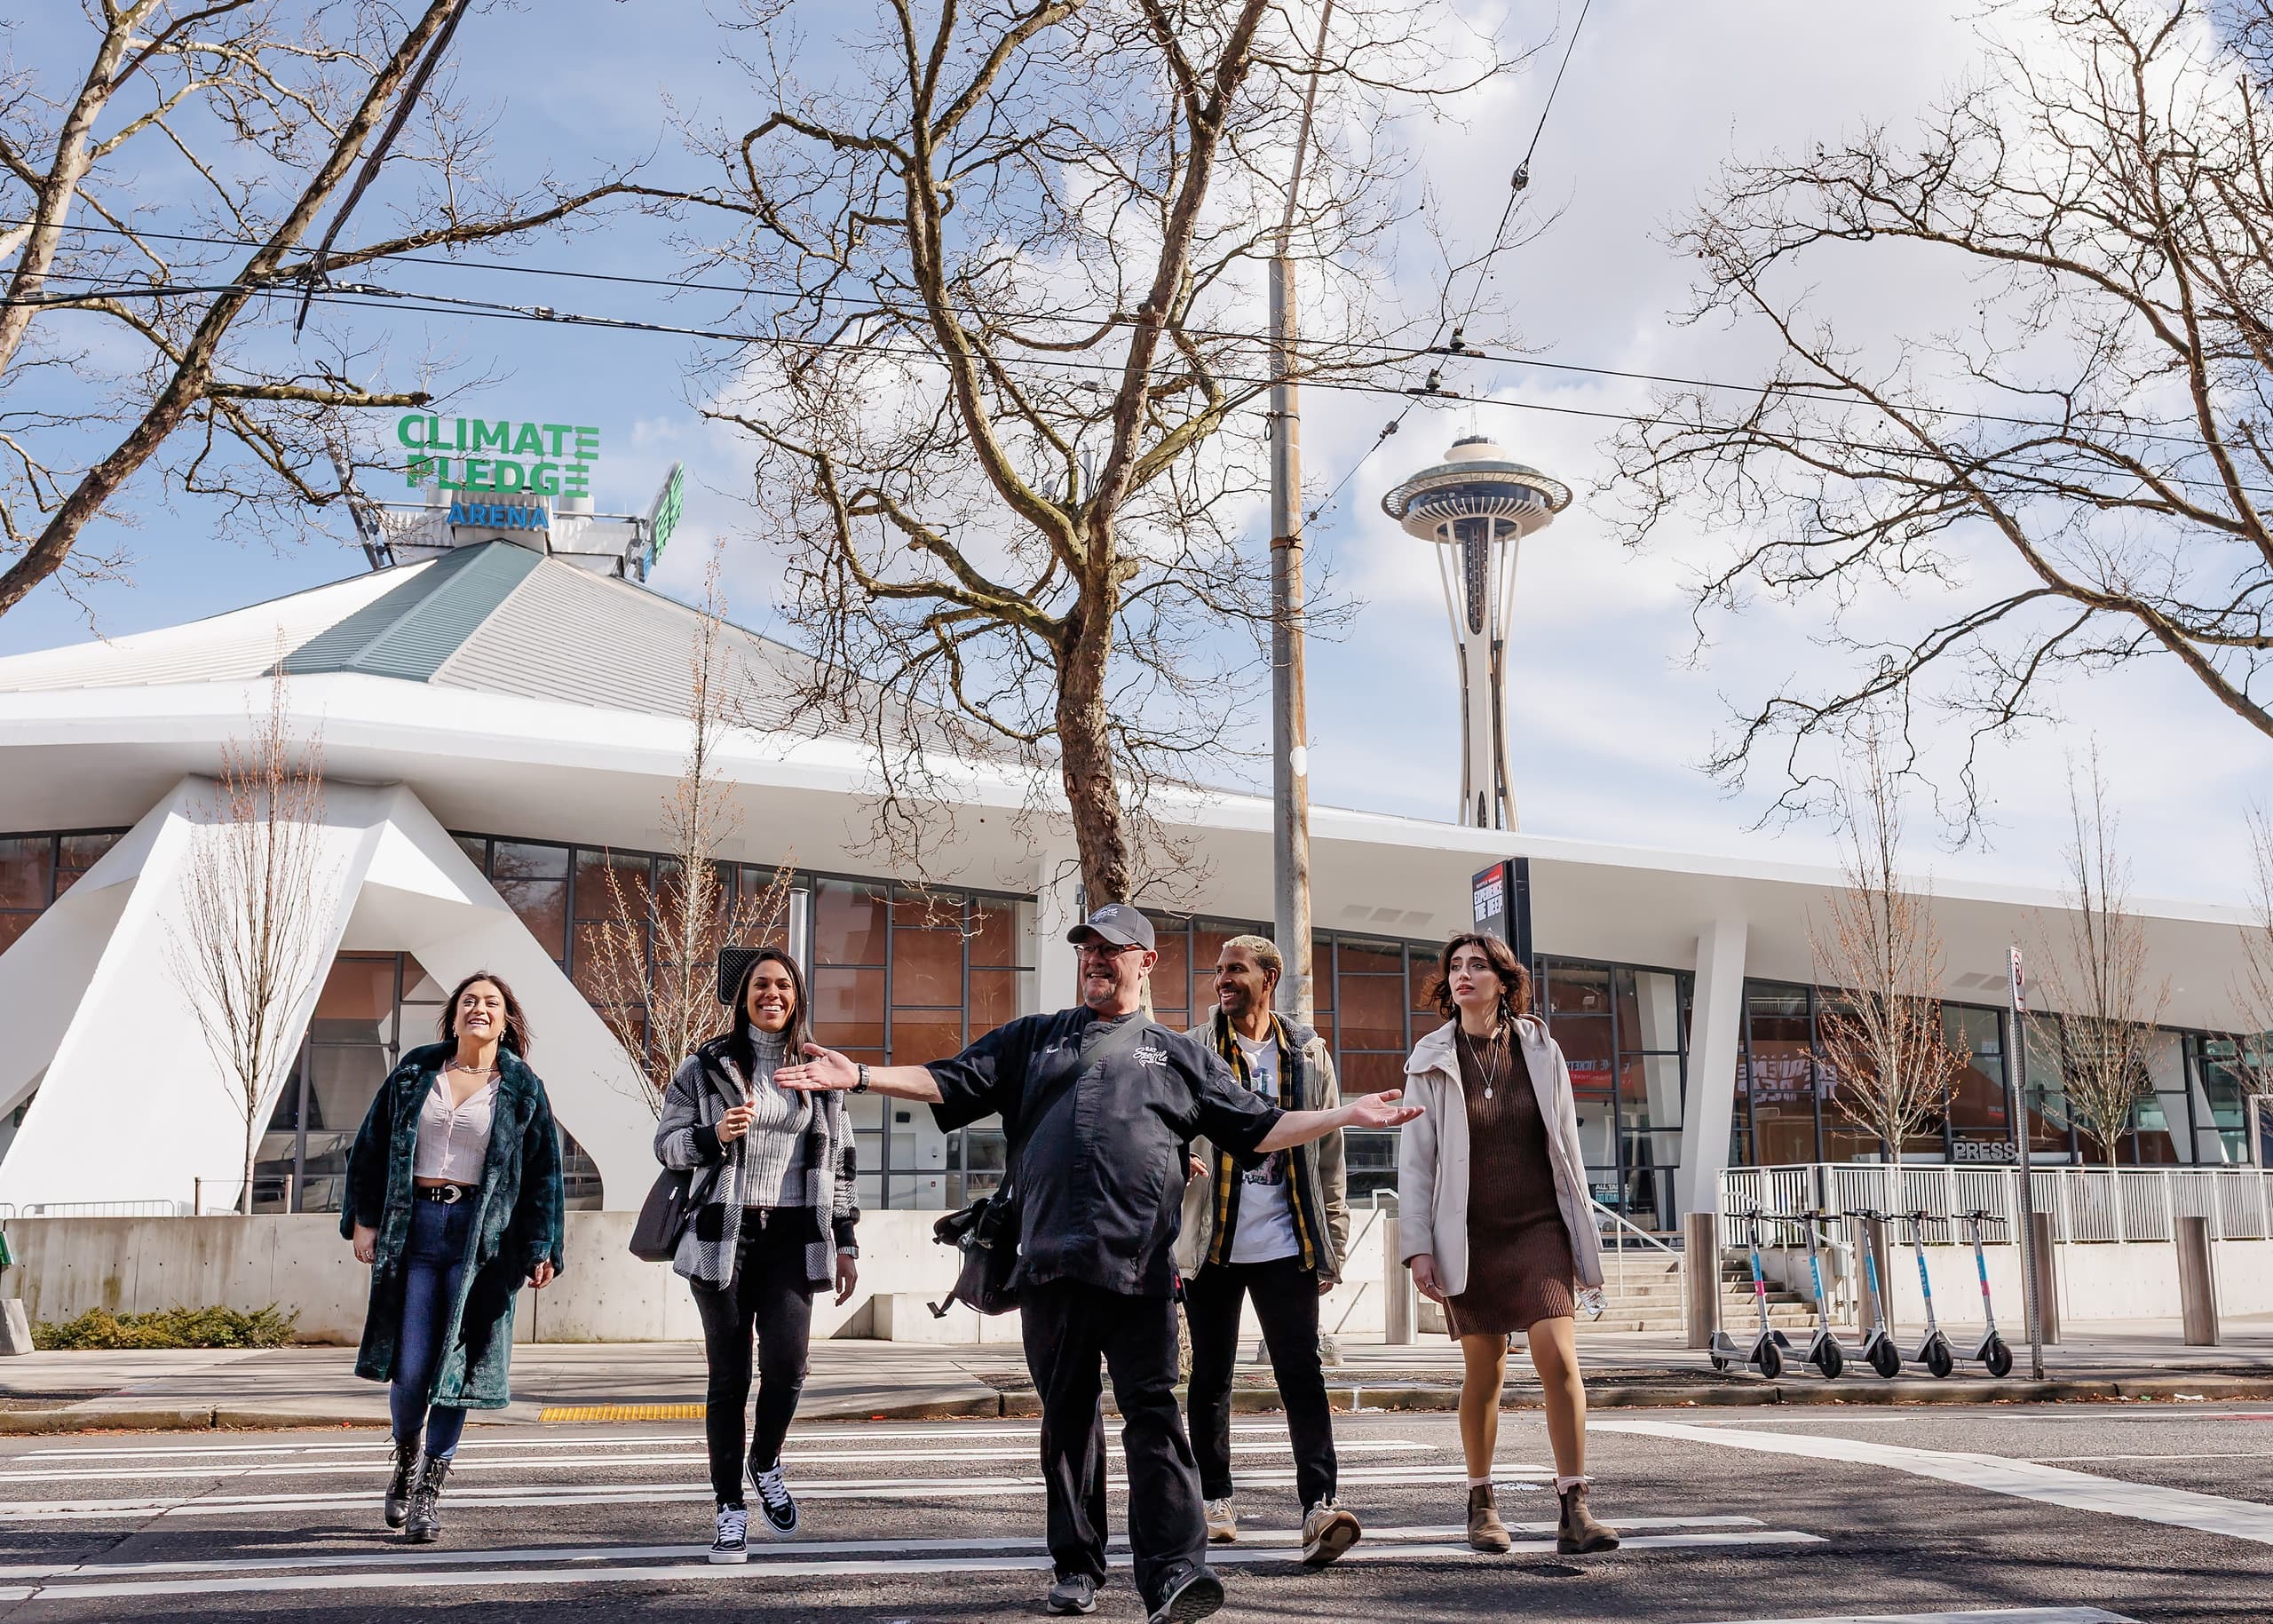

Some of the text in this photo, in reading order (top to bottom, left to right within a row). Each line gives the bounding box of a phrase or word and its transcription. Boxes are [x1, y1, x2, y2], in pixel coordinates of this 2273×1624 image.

[398, 414, 599, 460] CLIMATE
[407, 454, 589, 498] PLEDGE
[447, 502, 549, 529] ARENA
[1953, 1142, 2016, 1160] PRESS
